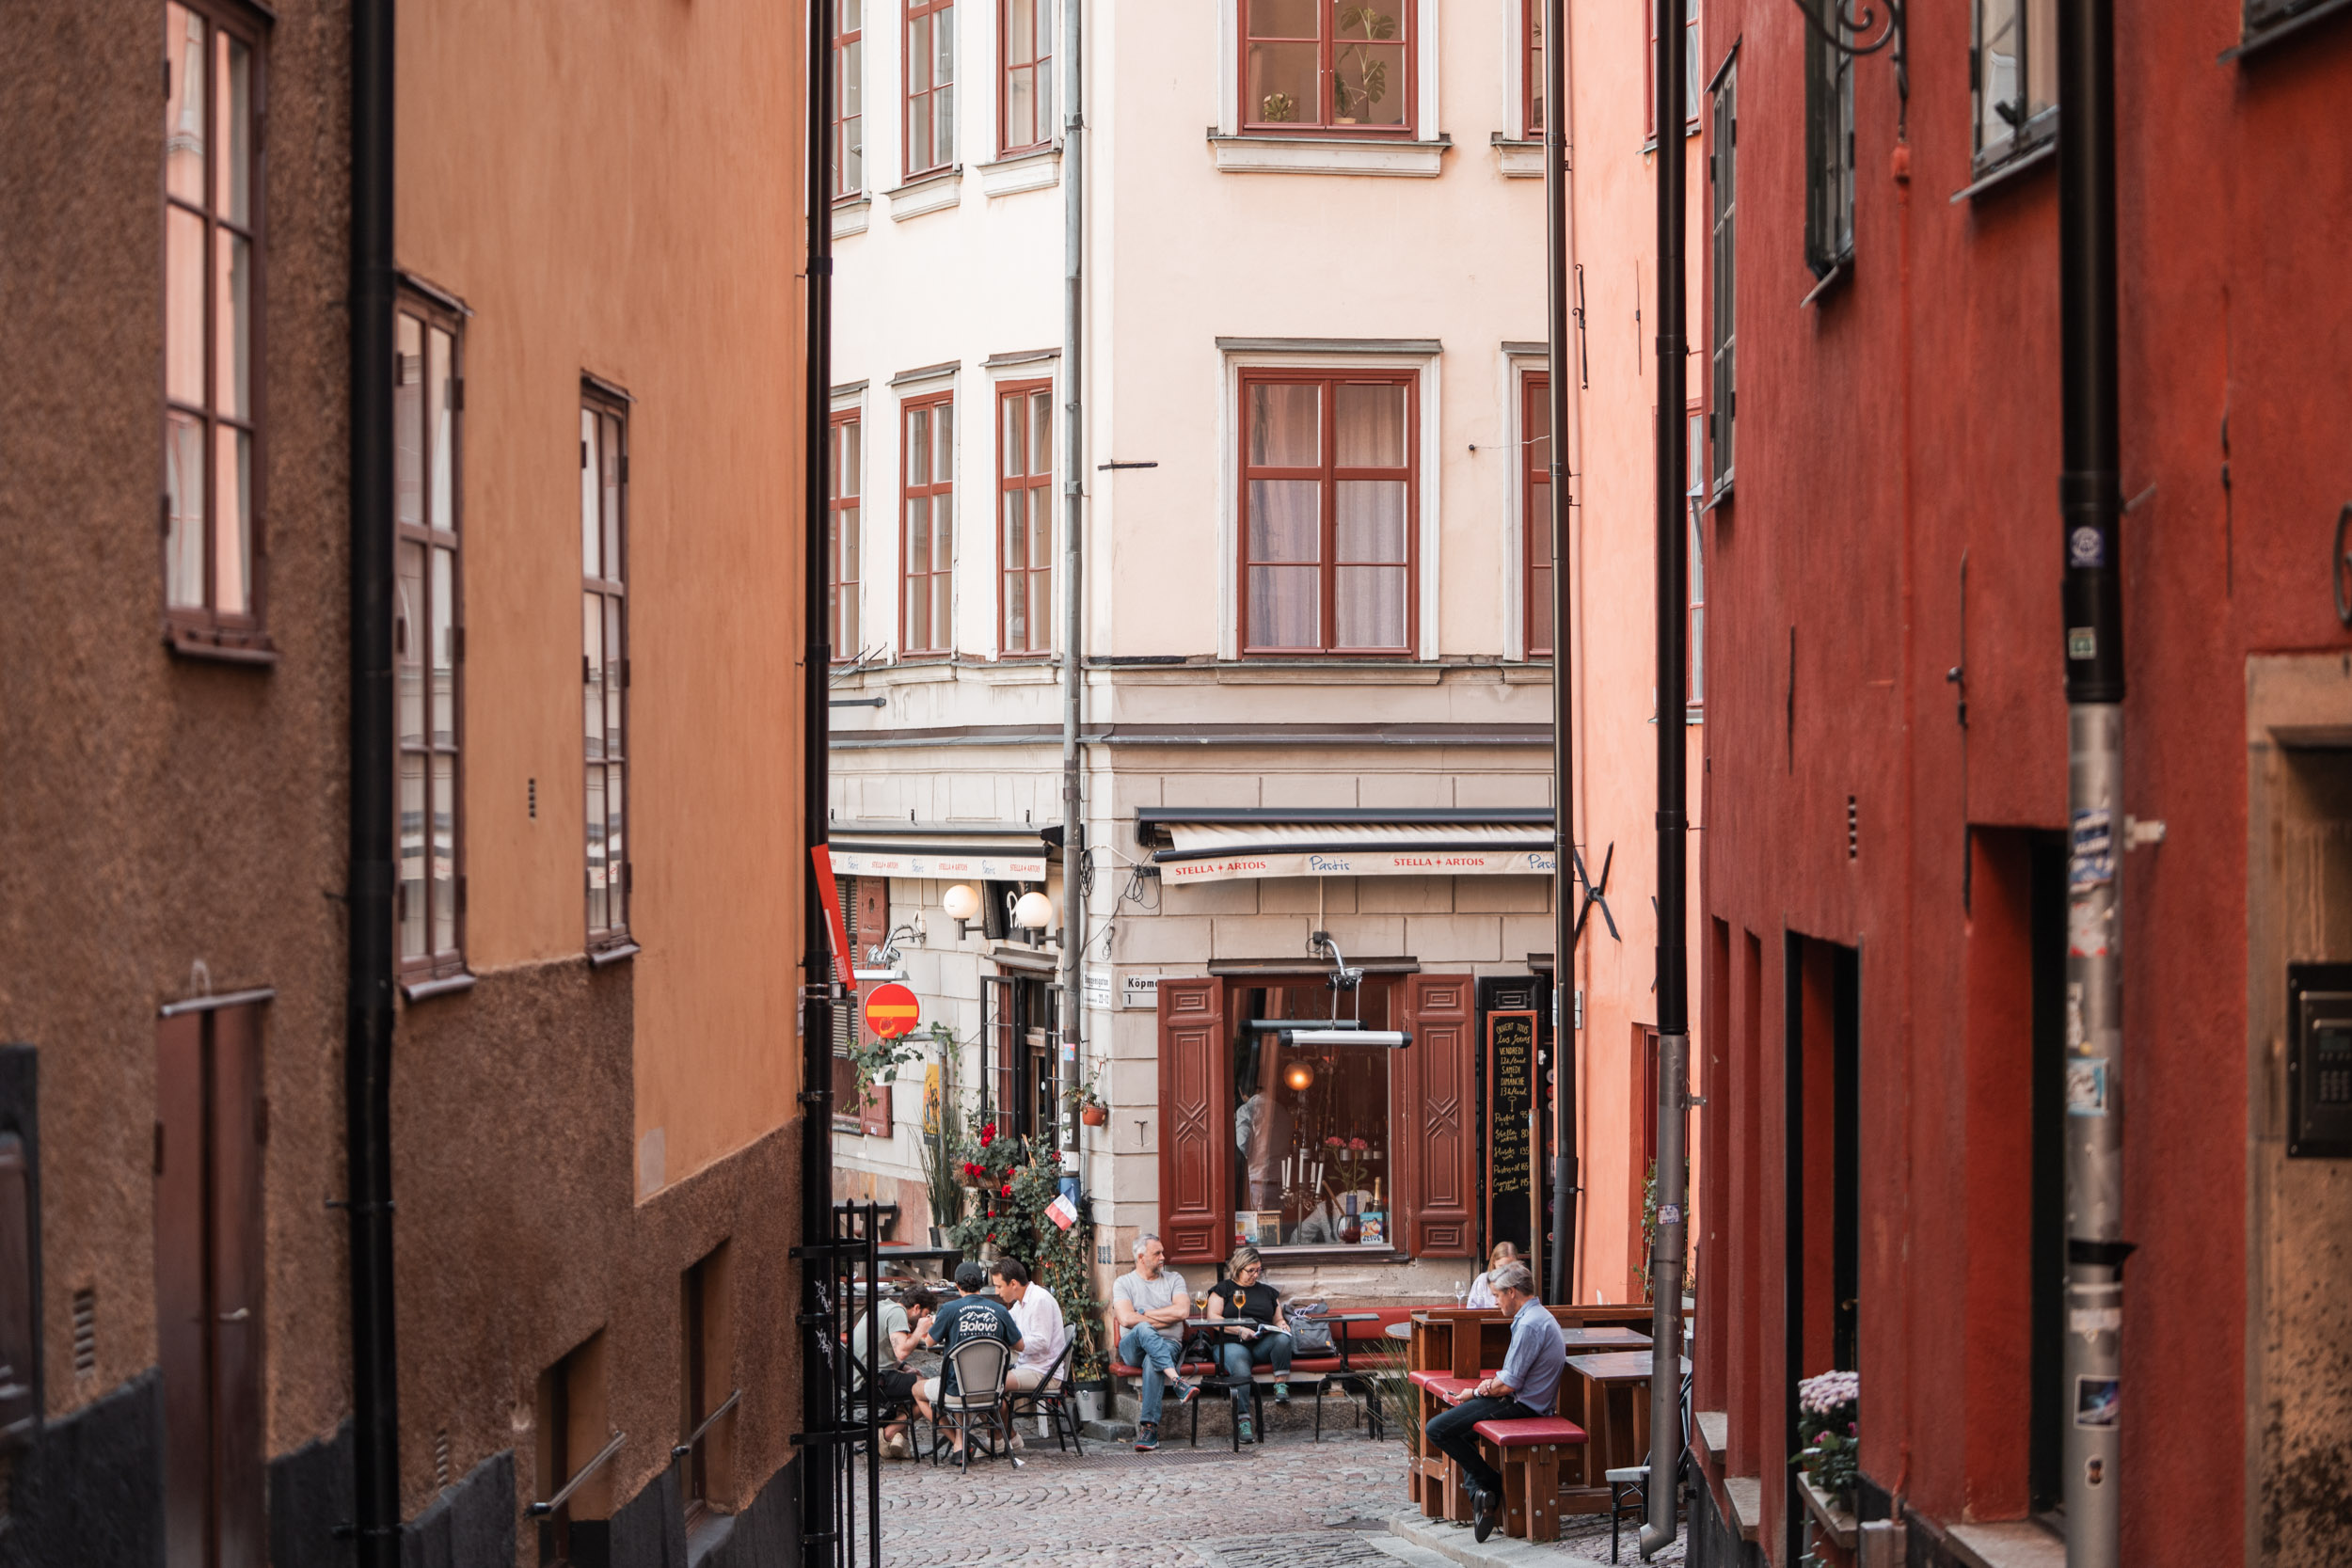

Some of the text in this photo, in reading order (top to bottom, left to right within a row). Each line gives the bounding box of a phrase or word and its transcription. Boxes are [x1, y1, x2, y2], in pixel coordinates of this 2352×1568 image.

[1309, 854, 1351, 872] Pastis
[1394, 858, 1485, 866] STELLA ARTOIS
[1527, 853, 1556, 869] Past
[1009, 863, 1024, 872] STELLA
[1175, 861, 1266, 876] STELLA ARTOIS
[1499, 1046, 1524, 1055] VENDREDI
[1502, 1065, 1521, 1075] SAMEDI
[1500, 1076, 1525, 1086] DIMANCHE
[960, 1321, 997, 1332] Bolovo
